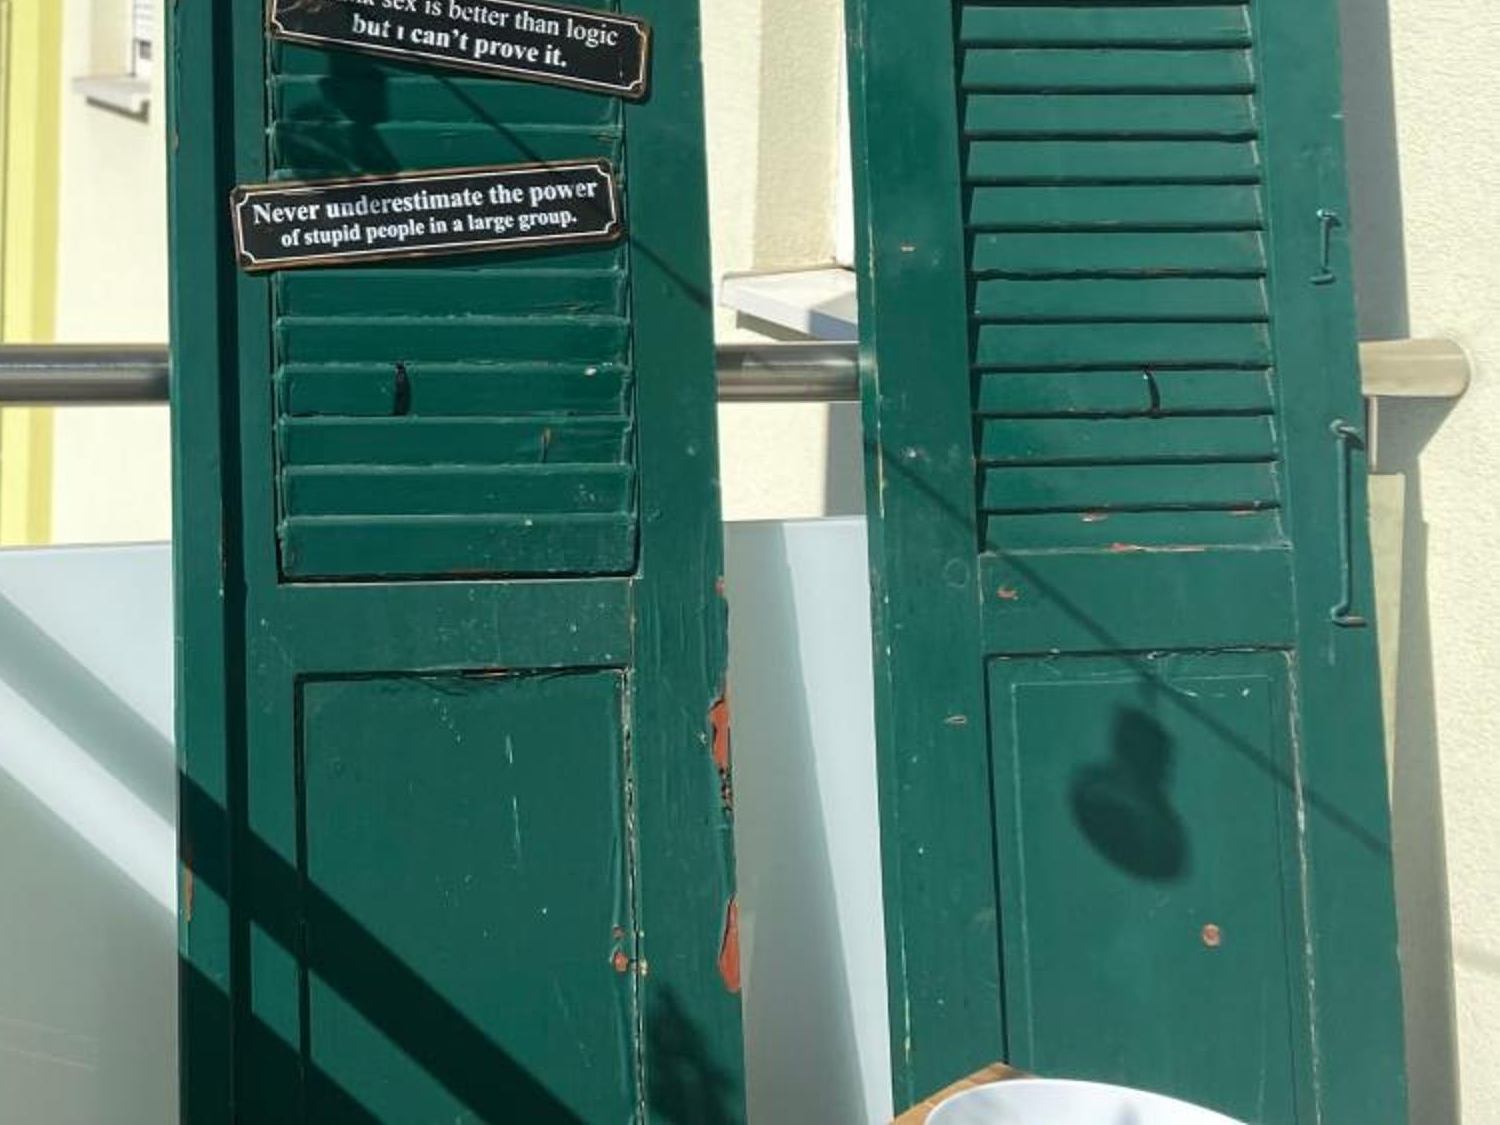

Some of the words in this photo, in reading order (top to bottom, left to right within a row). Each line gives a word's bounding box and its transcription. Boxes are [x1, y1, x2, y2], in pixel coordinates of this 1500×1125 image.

[351, 13, 390, 38] but
[410, 27, 468, 51] can't
[473, 37, 540, 65] prove
[544, 43, 568, 68] it.
[514, 9, 560, 37] than
[566, 17, 620, 48] logic
[251, 200, 321, 226] Never
[325, 187, 484, 220] underestimate
[488, 183, 523, 205] the
[530, 179, 599, 207] power
[280, 228, 301, 248] of
[303, 221, 362, 249] stupid
[365, 217, 425, 245] people
[429, 214, 448, 234] in
[452, 217, 463, 231] a
[467, 208, 515, 233] large
[518, 206, 578, 231] group.
